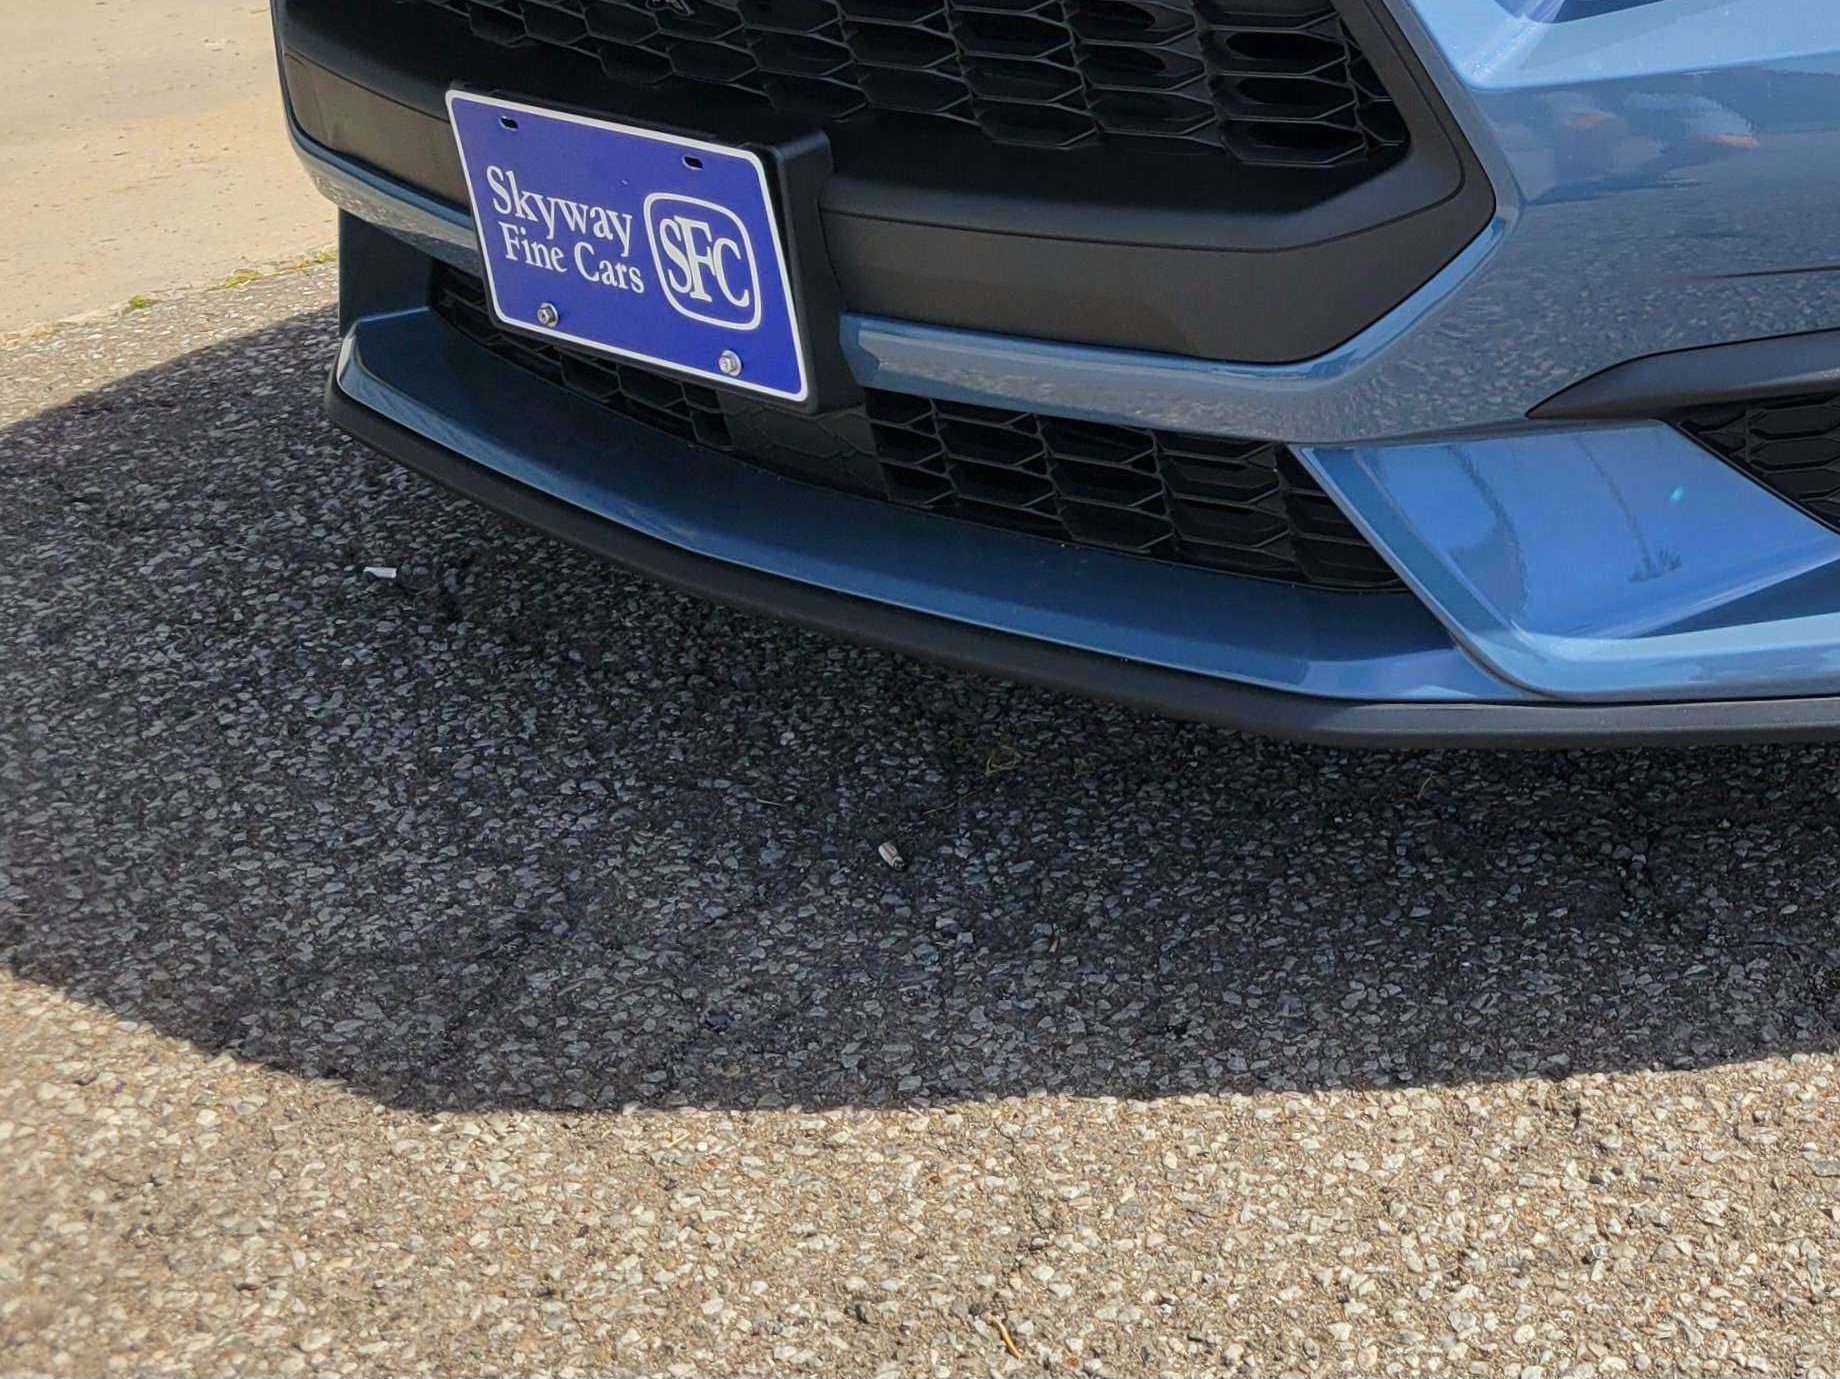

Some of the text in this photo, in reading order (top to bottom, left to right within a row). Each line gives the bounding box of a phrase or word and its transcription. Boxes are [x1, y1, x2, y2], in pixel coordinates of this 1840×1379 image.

[486, 165, 632, 257] Skyway
[498, 220, 646, 294] Fine Cars
[659, 214, 750, 308] SFC
